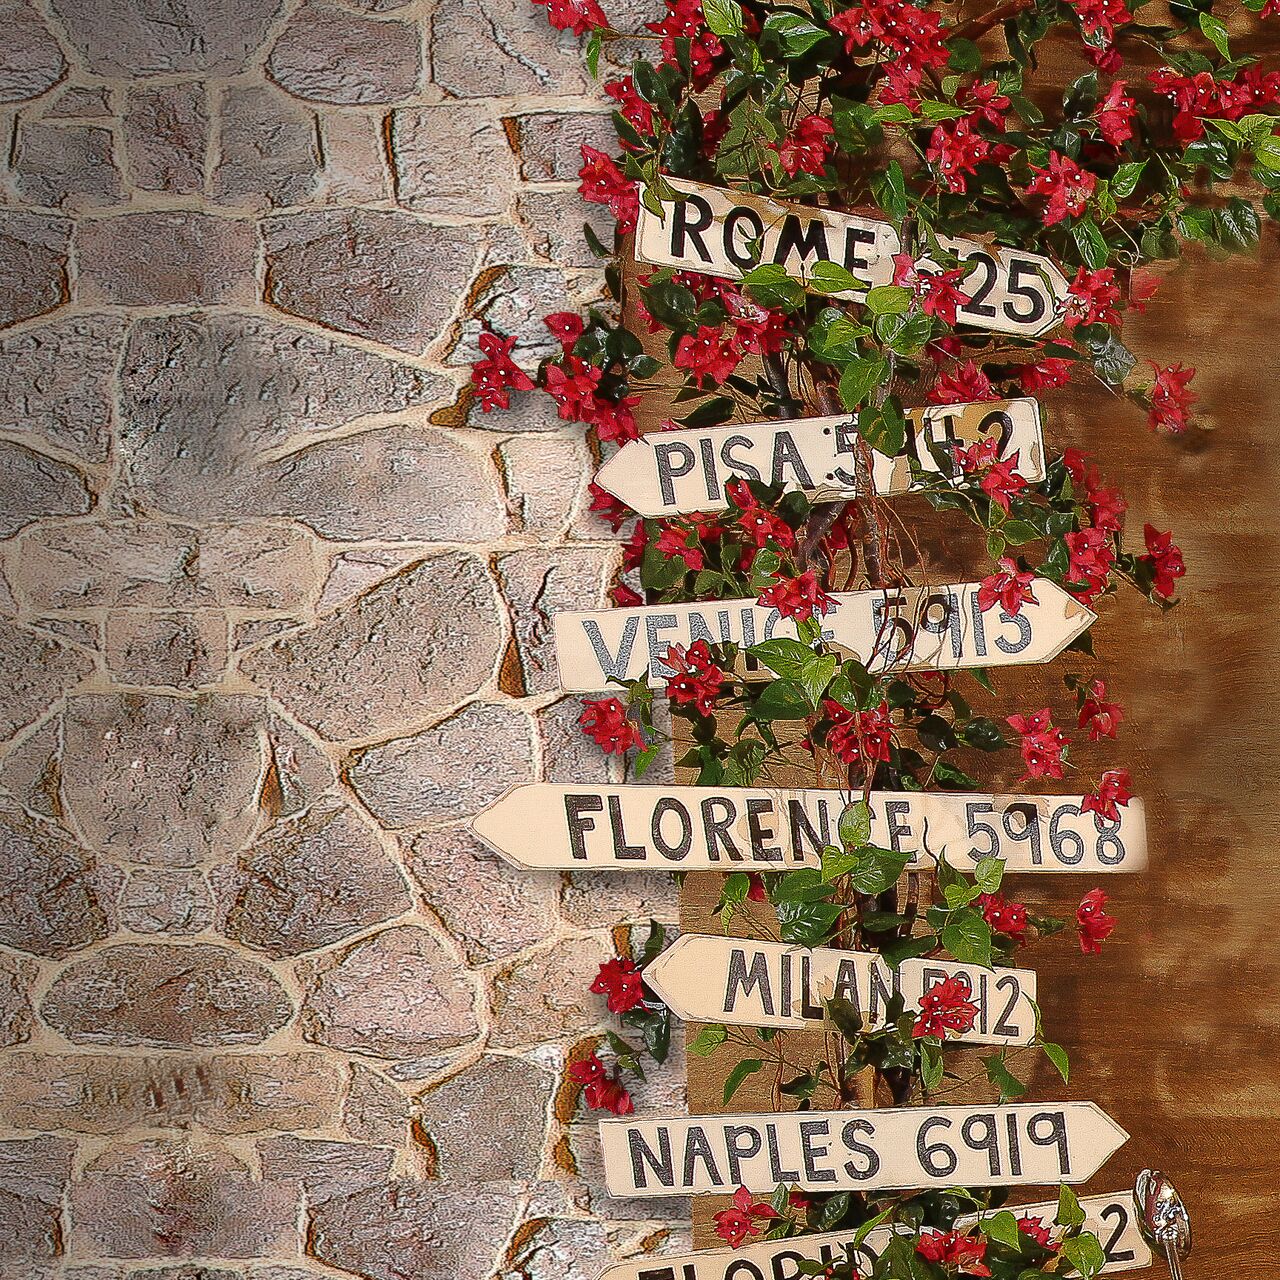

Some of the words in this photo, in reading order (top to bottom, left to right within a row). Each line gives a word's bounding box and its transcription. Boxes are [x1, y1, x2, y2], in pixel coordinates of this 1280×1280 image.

[670, 192, 876, 291] ROME
[917, 248, 1046, 323] 25
[655, 431, 816, 505] PISA
[965, 802, 1127, 865] 5968
[723, 949, 900, 1024] MILAN
[627, 1117, 883, 1190] NAPLES
[916, 1110, 1071, 1181] 6919
